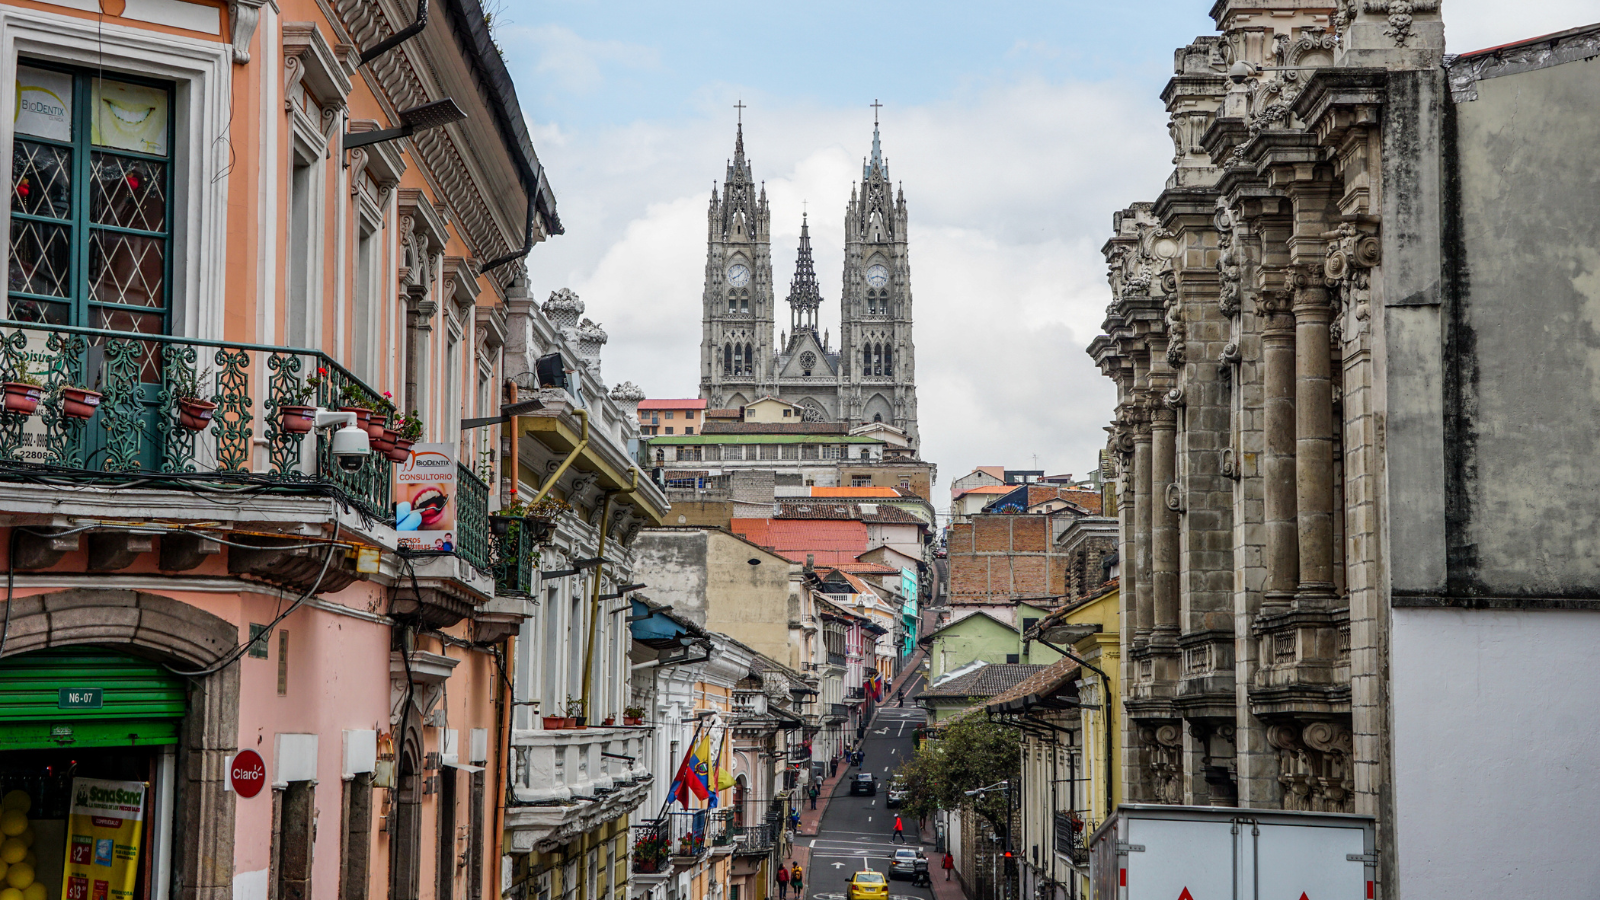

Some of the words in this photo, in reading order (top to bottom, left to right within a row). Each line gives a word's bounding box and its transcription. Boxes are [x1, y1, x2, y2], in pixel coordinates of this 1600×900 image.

[399, 473, 453, 481] CONSULTORIO
[69, 692, 93, 703] N6-07
[233, 766, 259, 780] Claro
